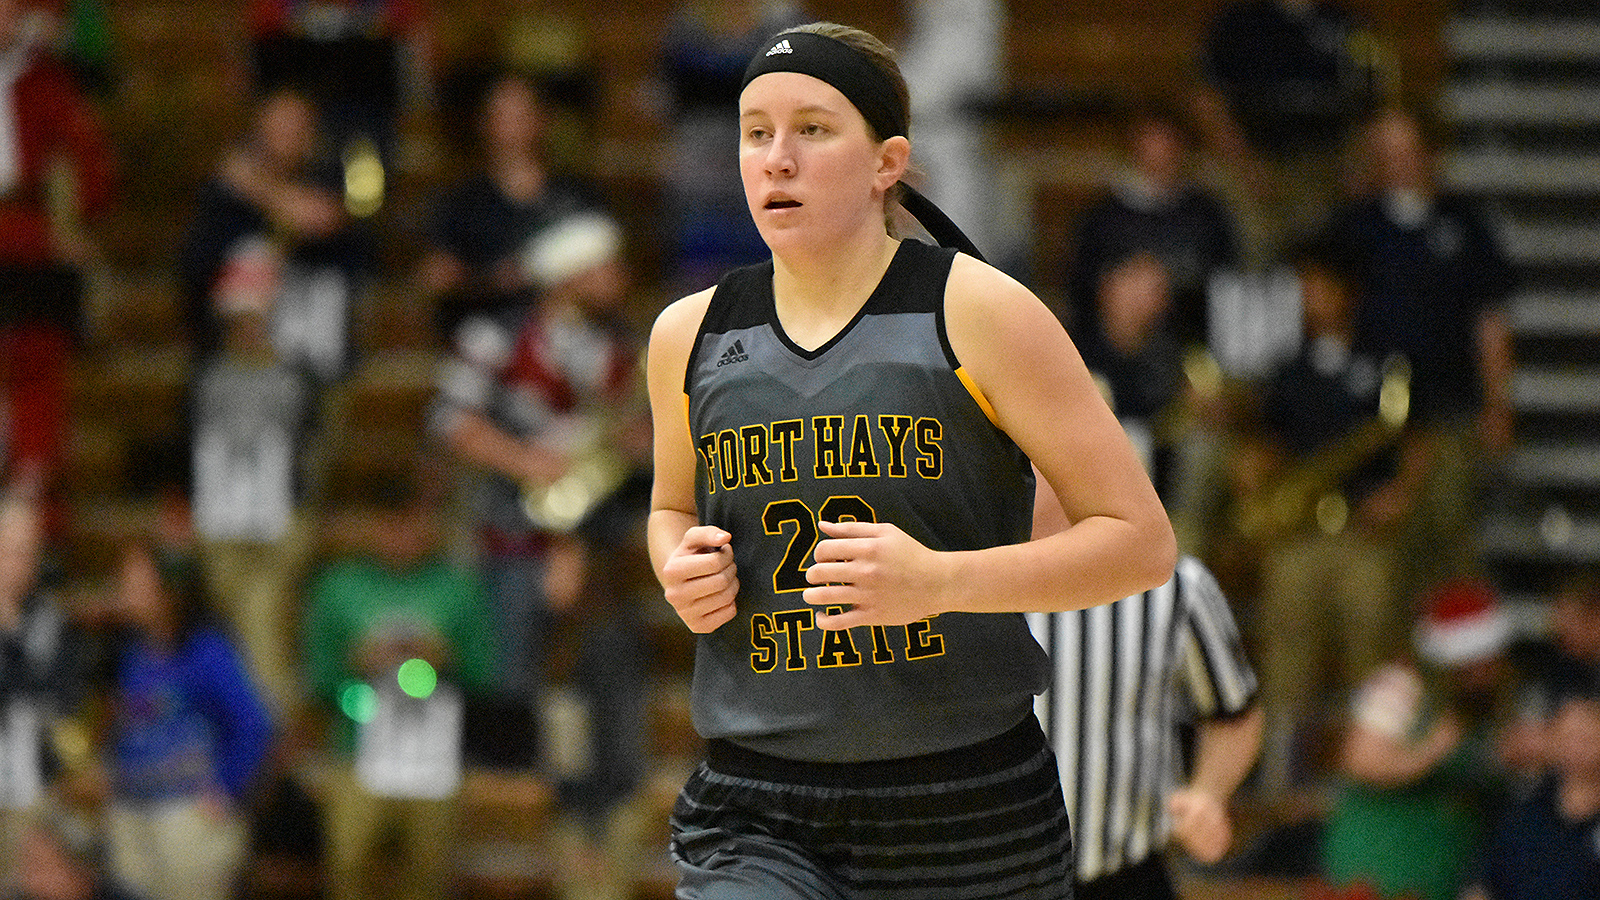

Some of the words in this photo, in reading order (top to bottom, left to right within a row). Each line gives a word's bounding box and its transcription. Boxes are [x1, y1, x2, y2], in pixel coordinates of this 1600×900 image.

[716, 353, 749, 367] adidas
[697, 418, 804, 494] FORT
[811, 414, 943, 480] HAYS
[761, 495, 877, 594] 2
